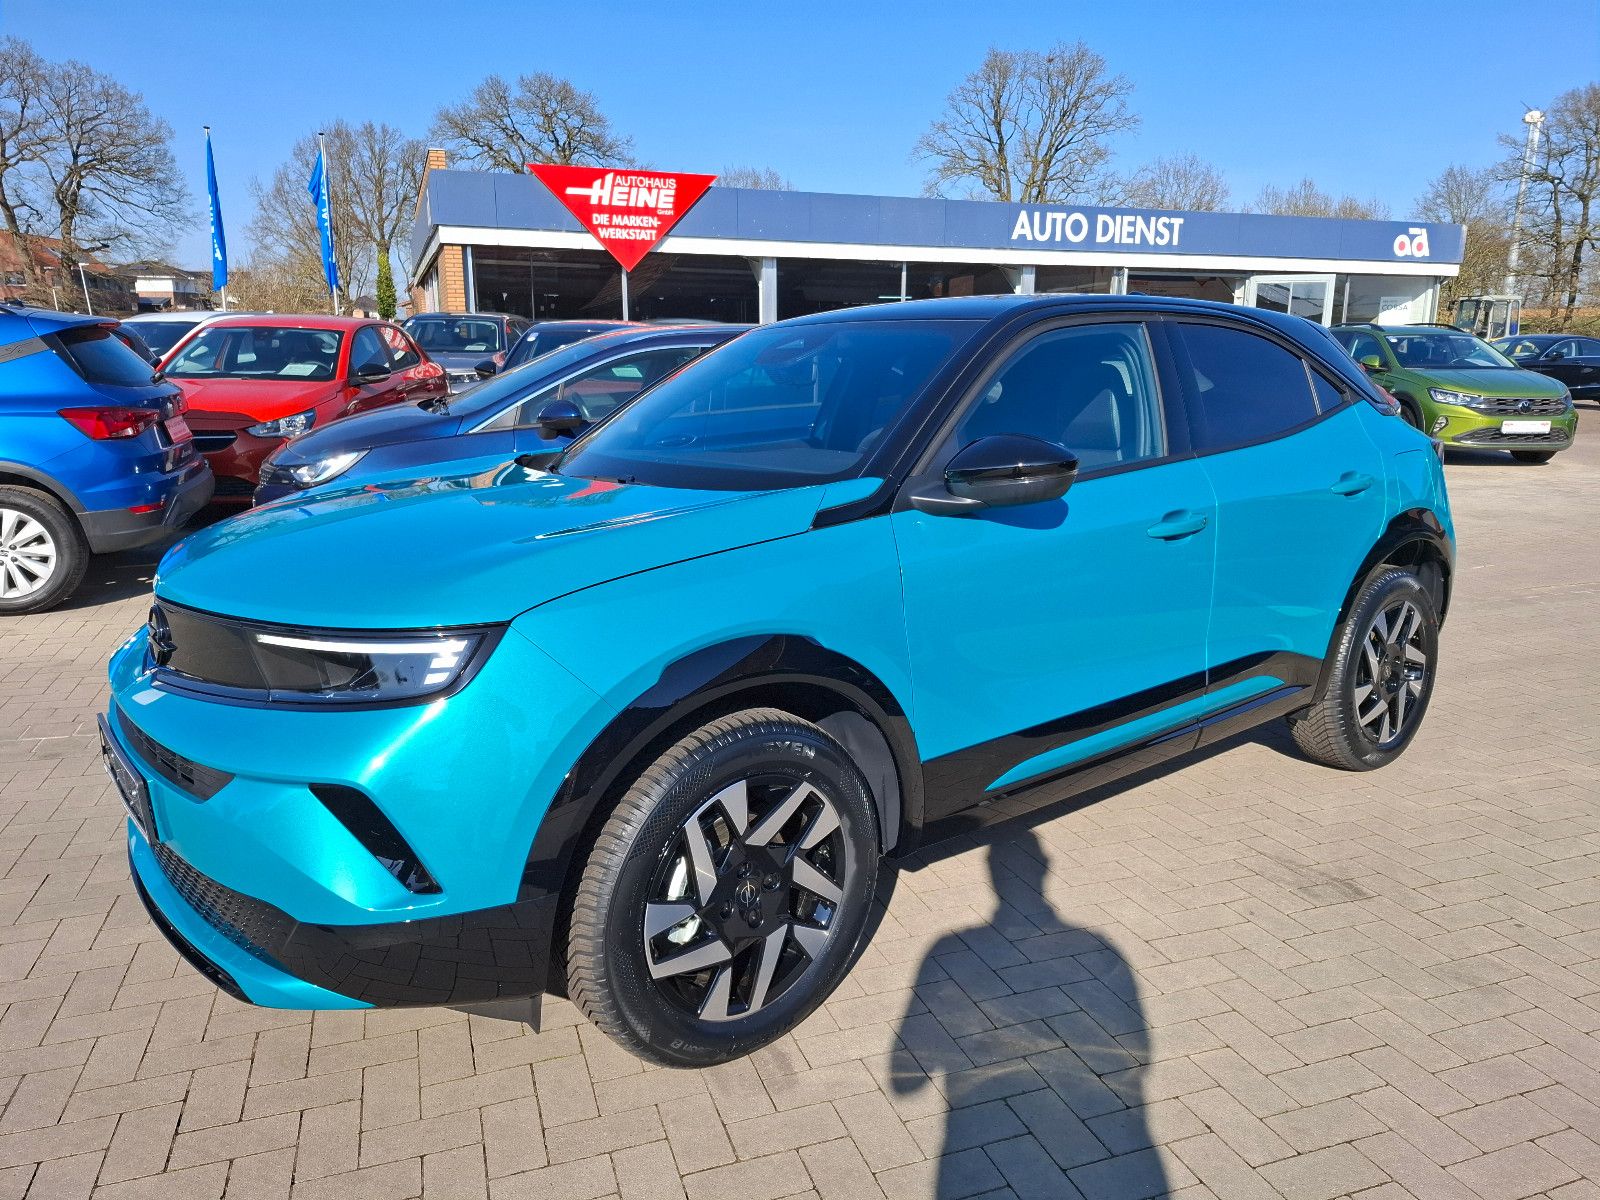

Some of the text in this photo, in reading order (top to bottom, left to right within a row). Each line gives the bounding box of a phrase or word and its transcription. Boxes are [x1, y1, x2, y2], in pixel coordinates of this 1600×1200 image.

[615, 176, 676, 188] AUTOHAUS
[566, 172, 676, 209] HEINE
[592, 213, 661, 228] DIE MARKEN-
[1011, 210, 1184, 246] AUTO DIENST
[598, 227, 657, 241] WERKSTATT
